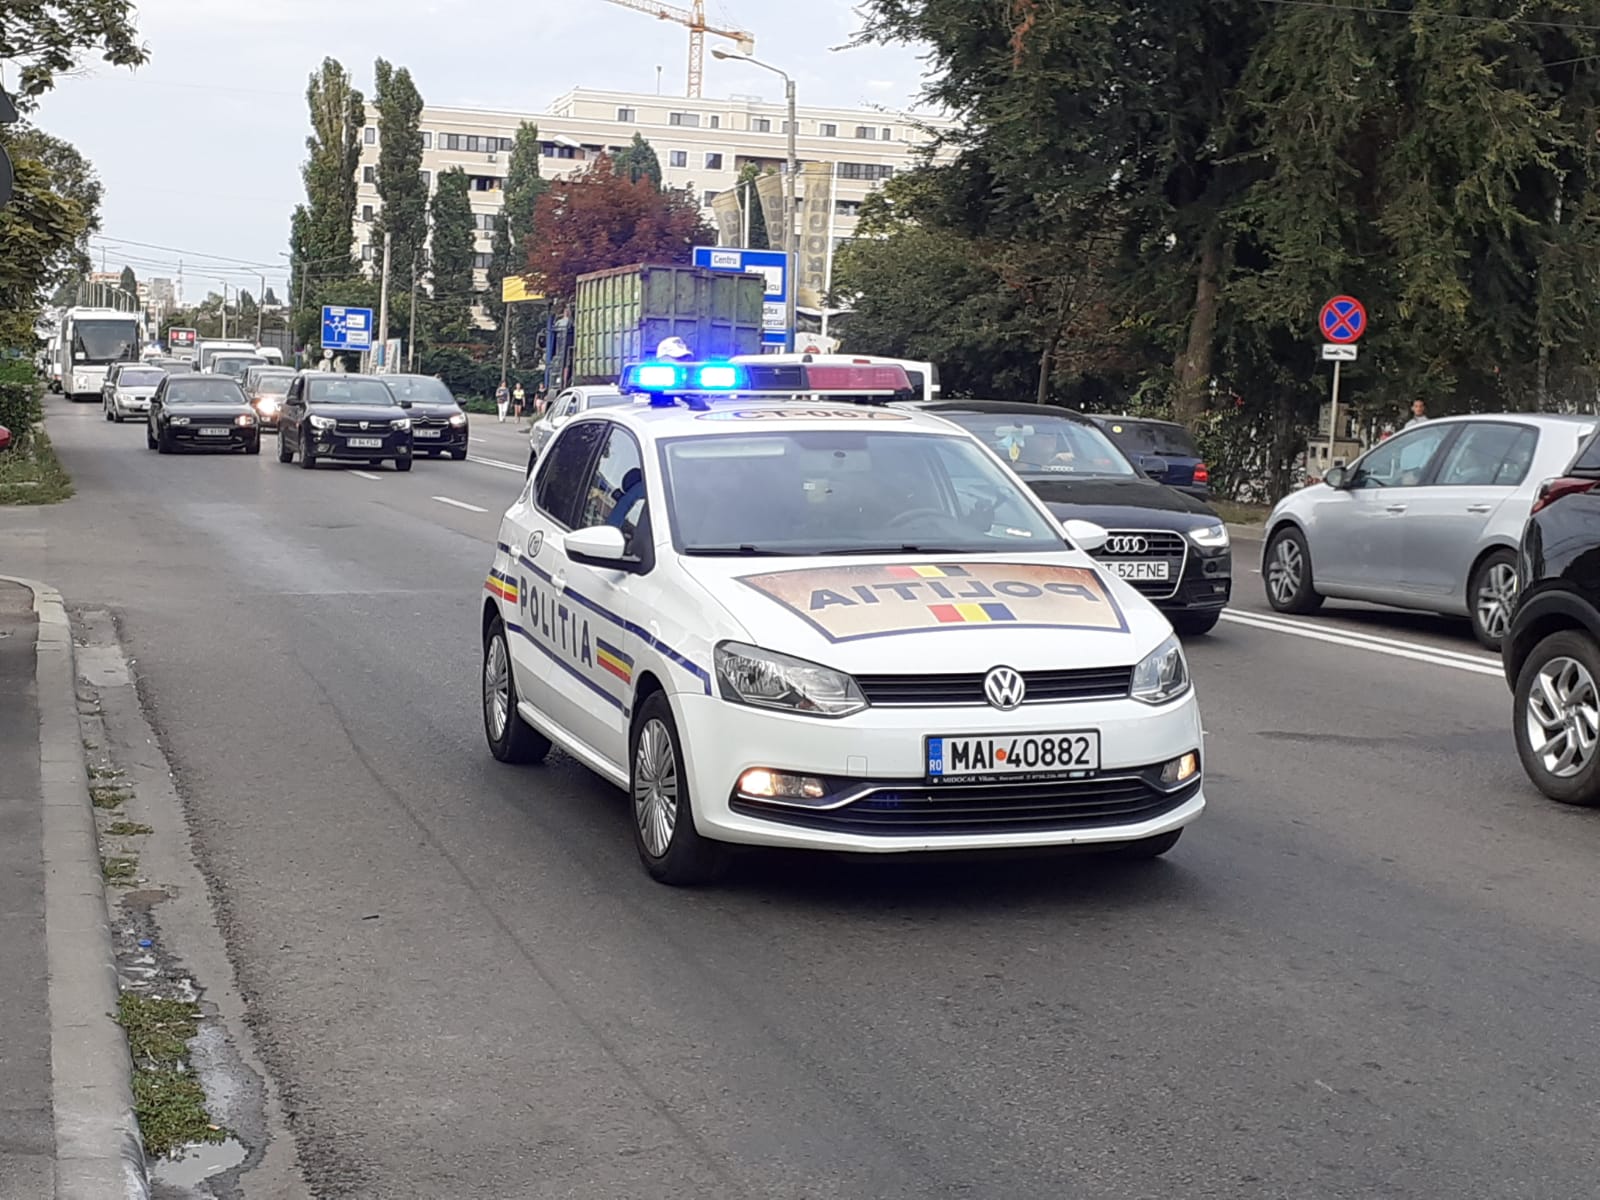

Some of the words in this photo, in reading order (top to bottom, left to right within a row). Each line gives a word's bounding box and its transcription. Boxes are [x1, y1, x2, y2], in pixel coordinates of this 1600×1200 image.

[714, 255, 737, 264] Centru
[733, 411, 876, 419] CT-067
[1118, 563, 1135, 578] 52
[1137, 563, 1166, 578] FNE
[520, 576, 593, 669] POLITIA
[951, 740, 994, 770] MAI
[1006, 737, 1090, 768] 40882
[928, 759, 943, 772] RO
